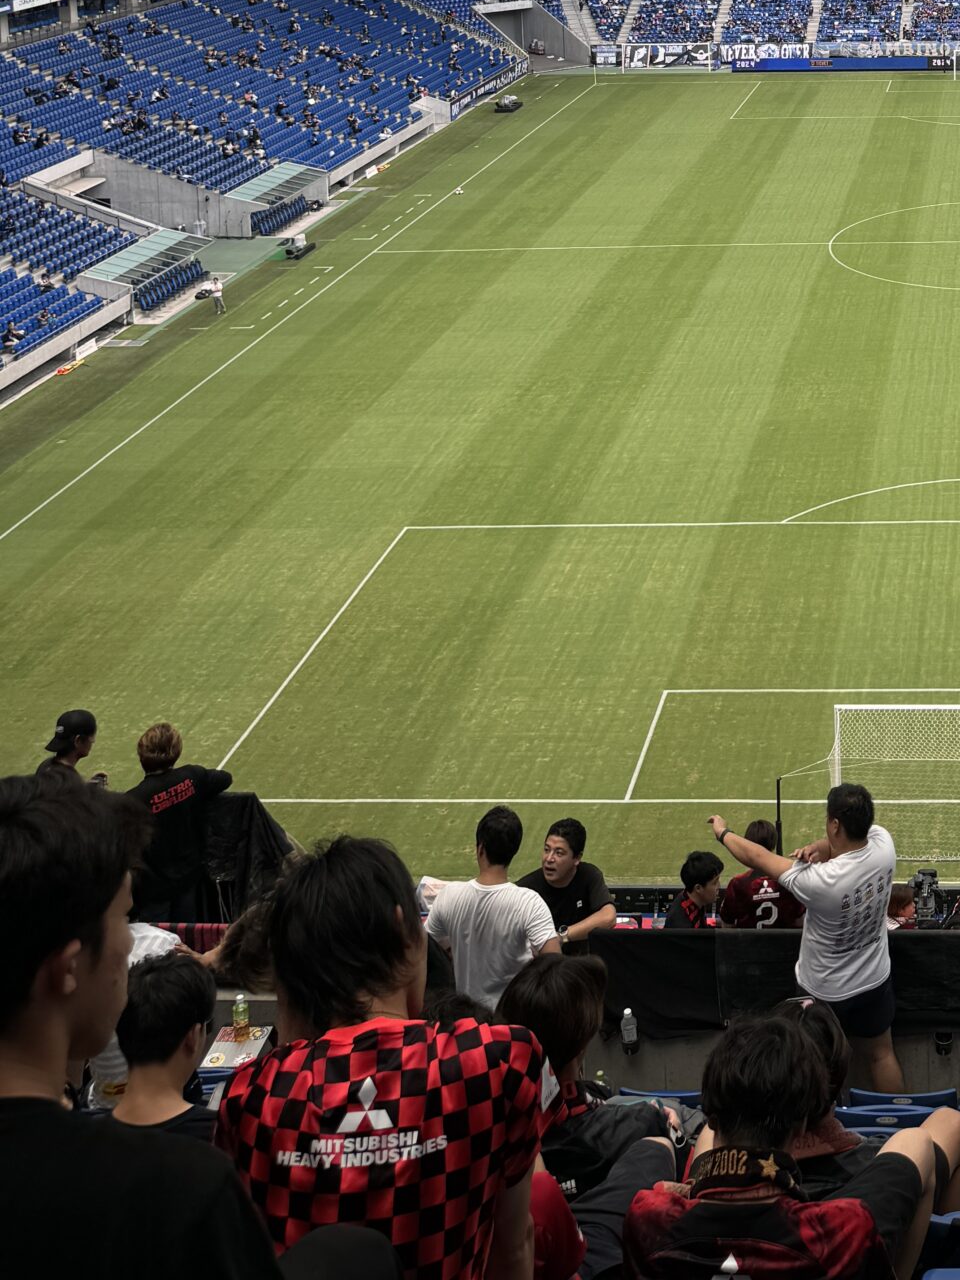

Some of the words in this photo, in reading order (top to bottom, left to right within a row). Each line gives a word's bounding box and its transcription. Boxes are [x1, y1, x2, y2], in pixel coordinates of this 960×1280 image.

[756, 901, 779, 929] 2
[276, 1150, 336, 1169] HEAVY
[340, 1135, 448, 1168] INDUSTRIES
[310, 1130, 419, 1154] MITSUBISHI
[712, 1149, 748, 1176] 2002
